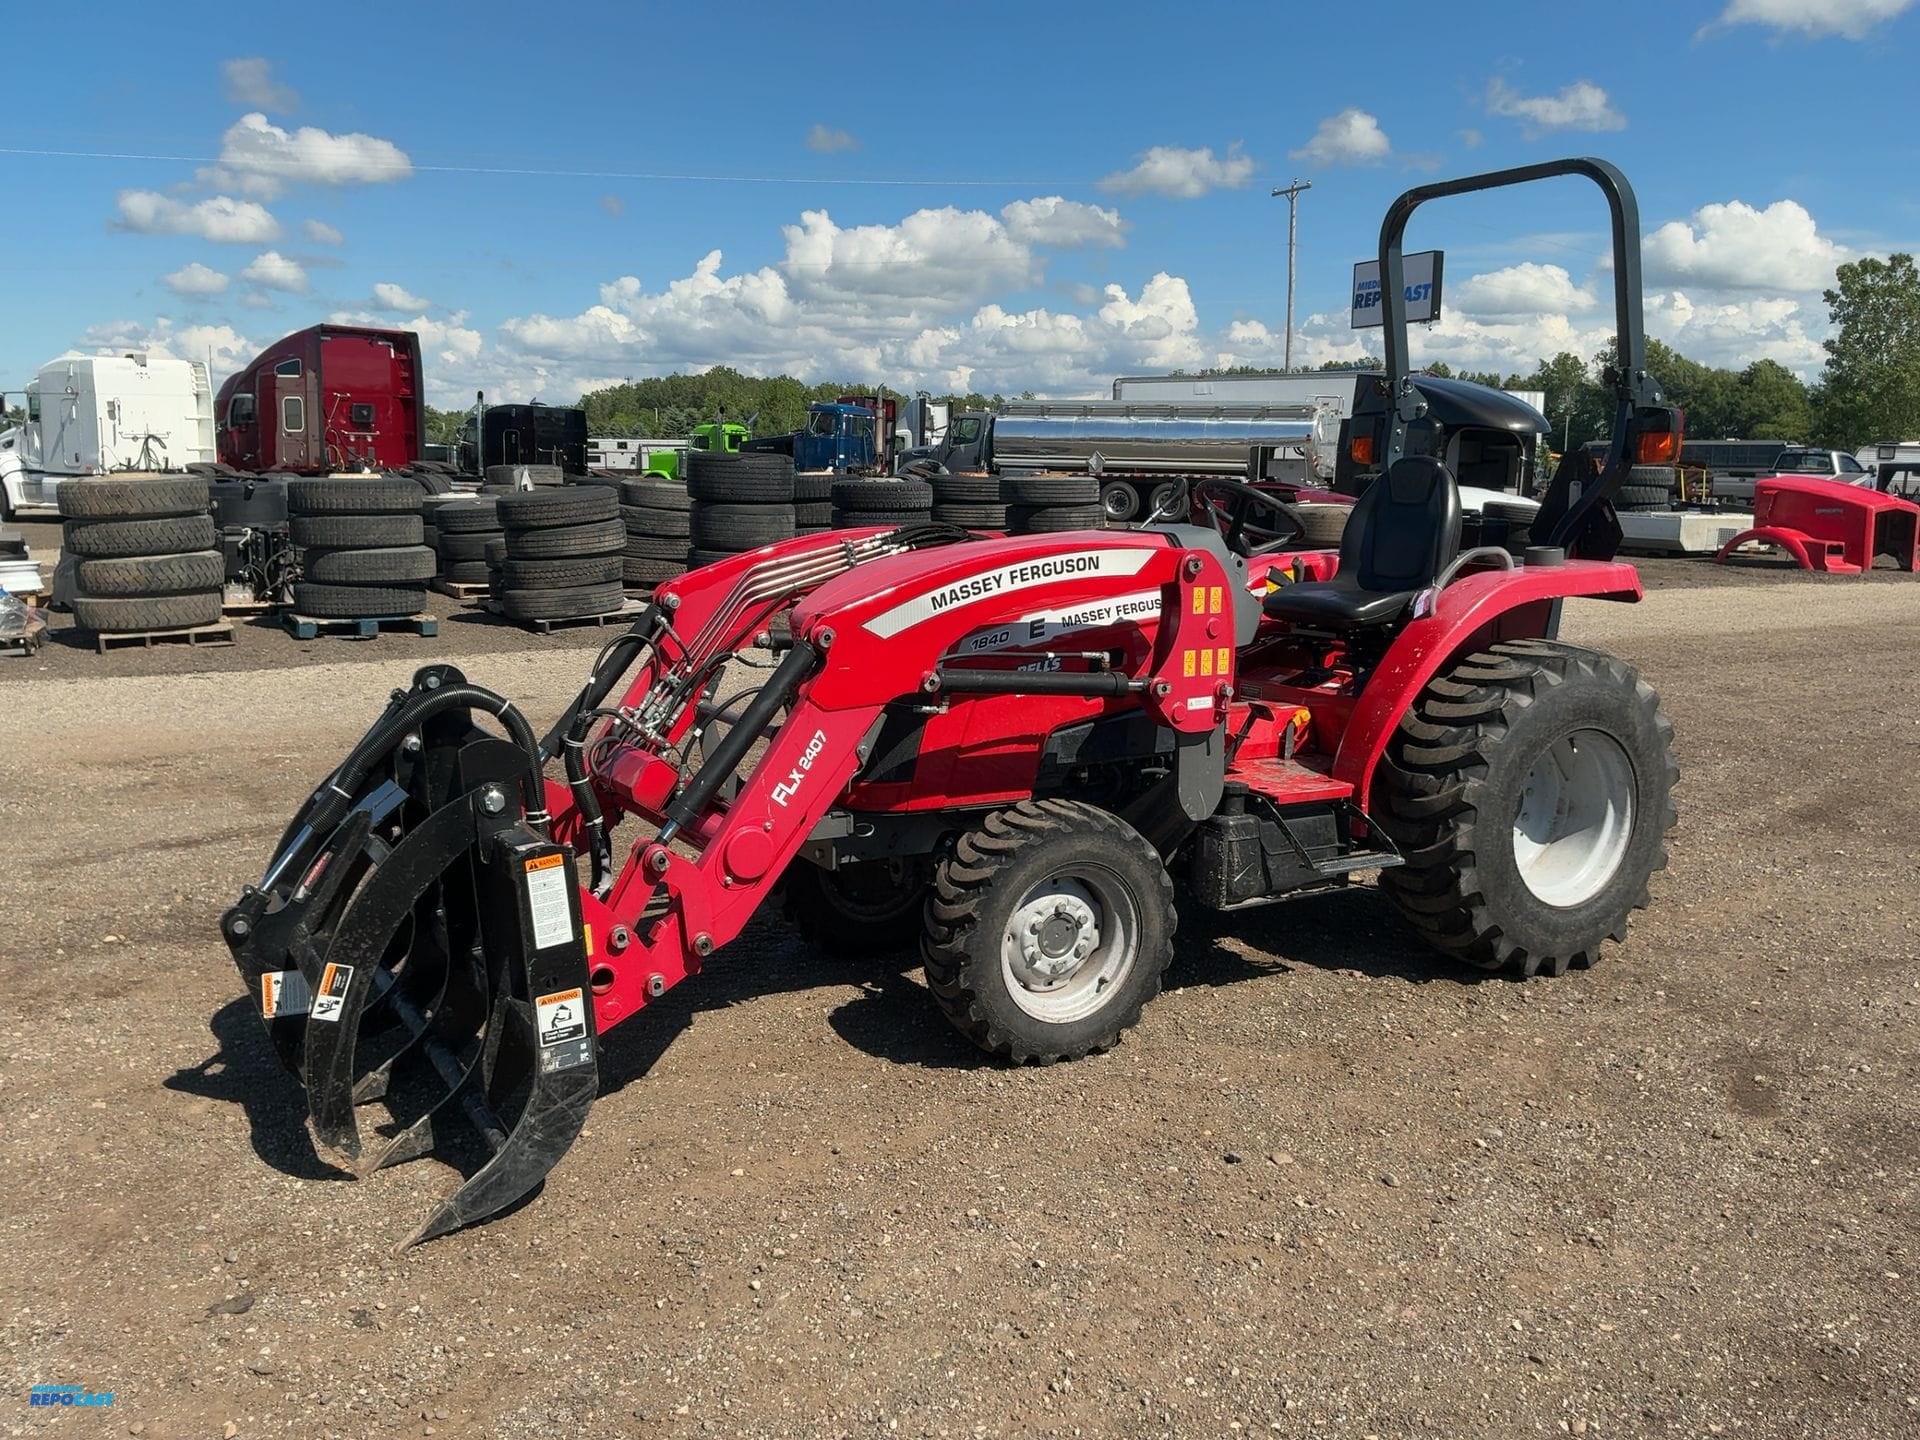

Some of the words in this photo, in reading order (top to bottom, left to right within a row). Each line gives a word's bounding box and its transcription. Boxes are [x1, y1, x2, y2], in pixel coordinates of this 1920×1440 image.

[1354, 283, 1432, 309] REPAST
[930, 573, 1003, 611] MASSEY
[1009, 555, 1100, 585] FERGUSON
[970, 631, 1010, 651] 1840
[1029, 617, 1046, 640] E
[1061, 607, 1112, 628] MASSEY
[1116, 598, 1162, 616] FERGUS
[771, 768, 805, 807] FLX
[799, 729, 827, 770] 2407
[547, 991, 579, 1004] WARNING
